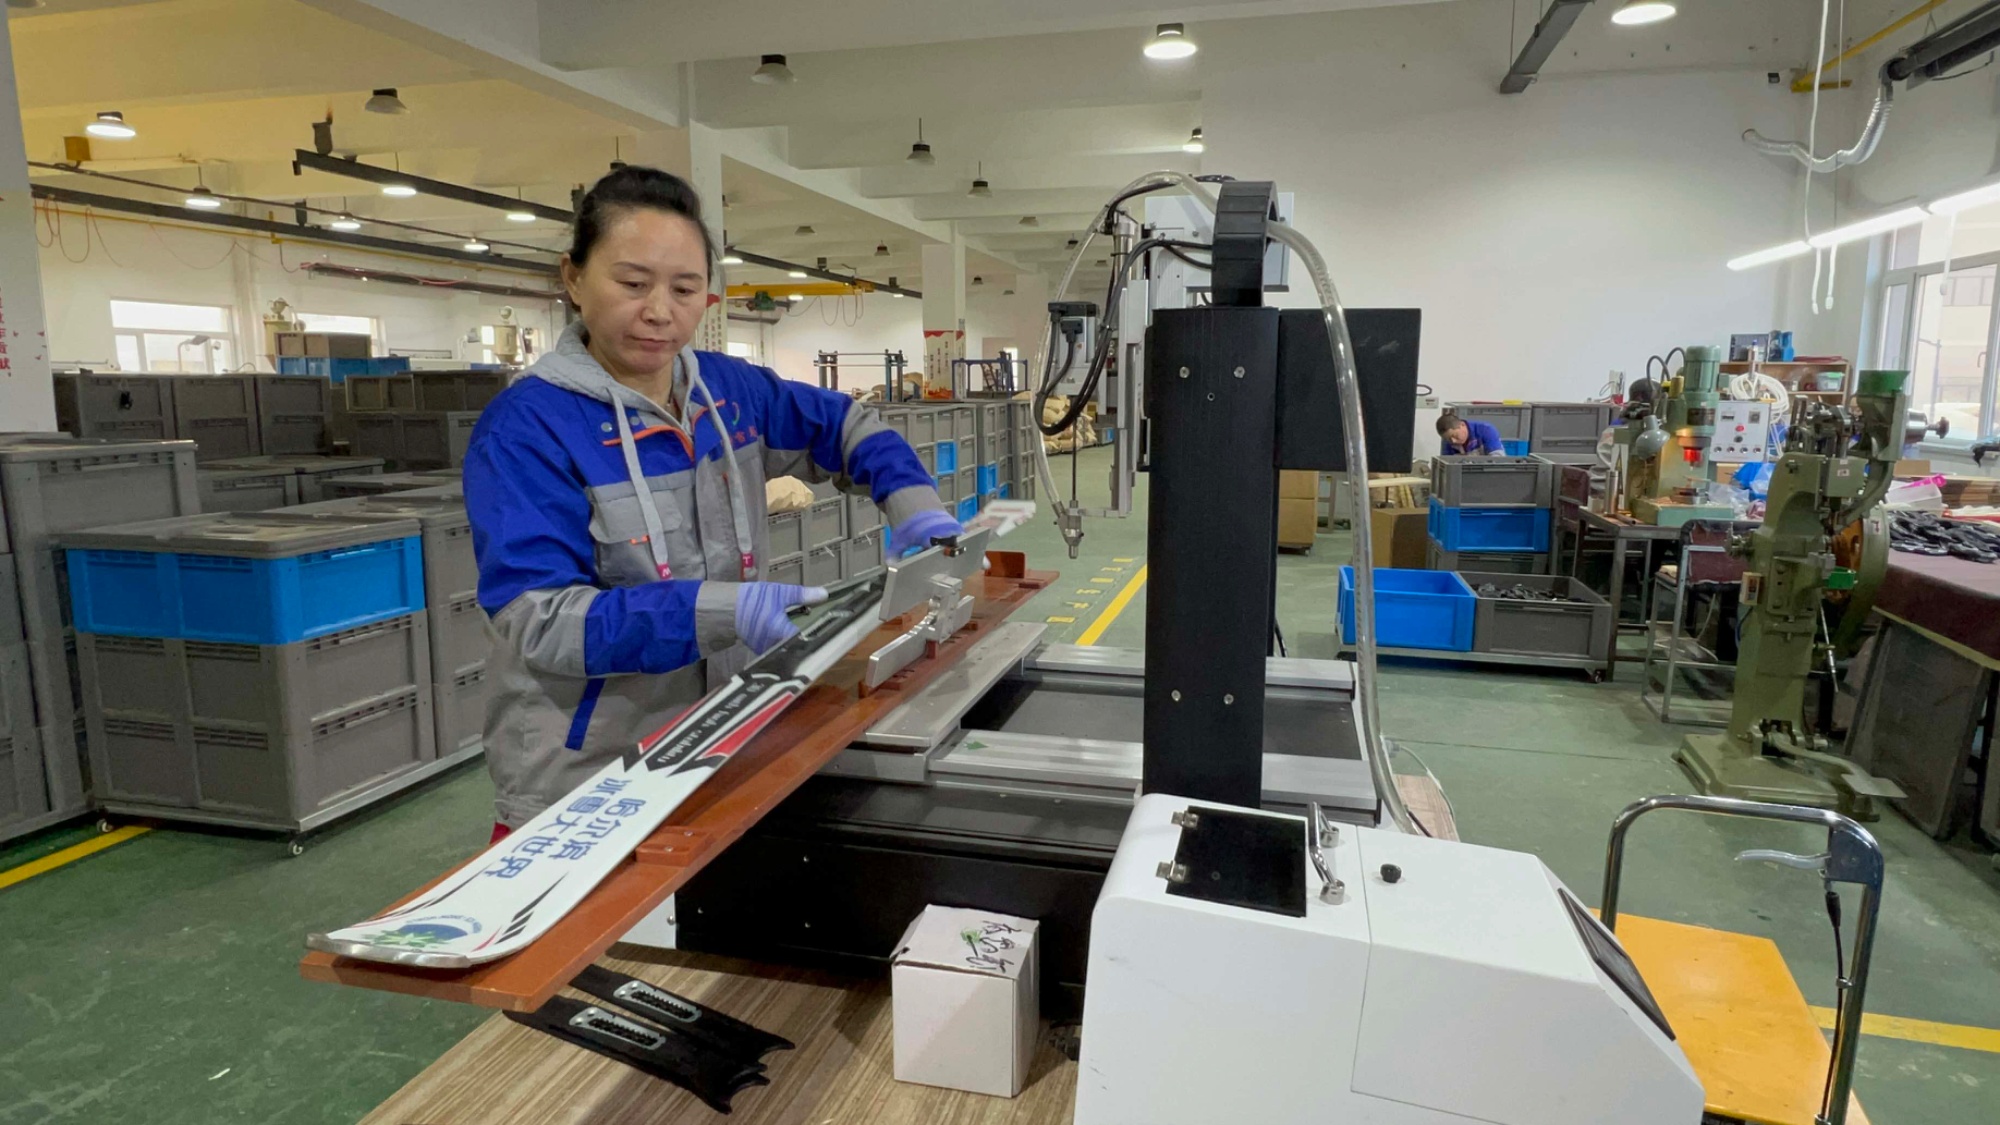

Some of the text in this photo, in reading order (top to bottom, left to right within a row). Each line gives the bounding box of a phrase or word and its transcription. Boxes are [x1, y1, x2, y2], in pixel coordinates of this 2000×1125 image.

[484, 776, 633, 880] 冰雪大世界
[548, 797, 647, 861] 哈尔滨
